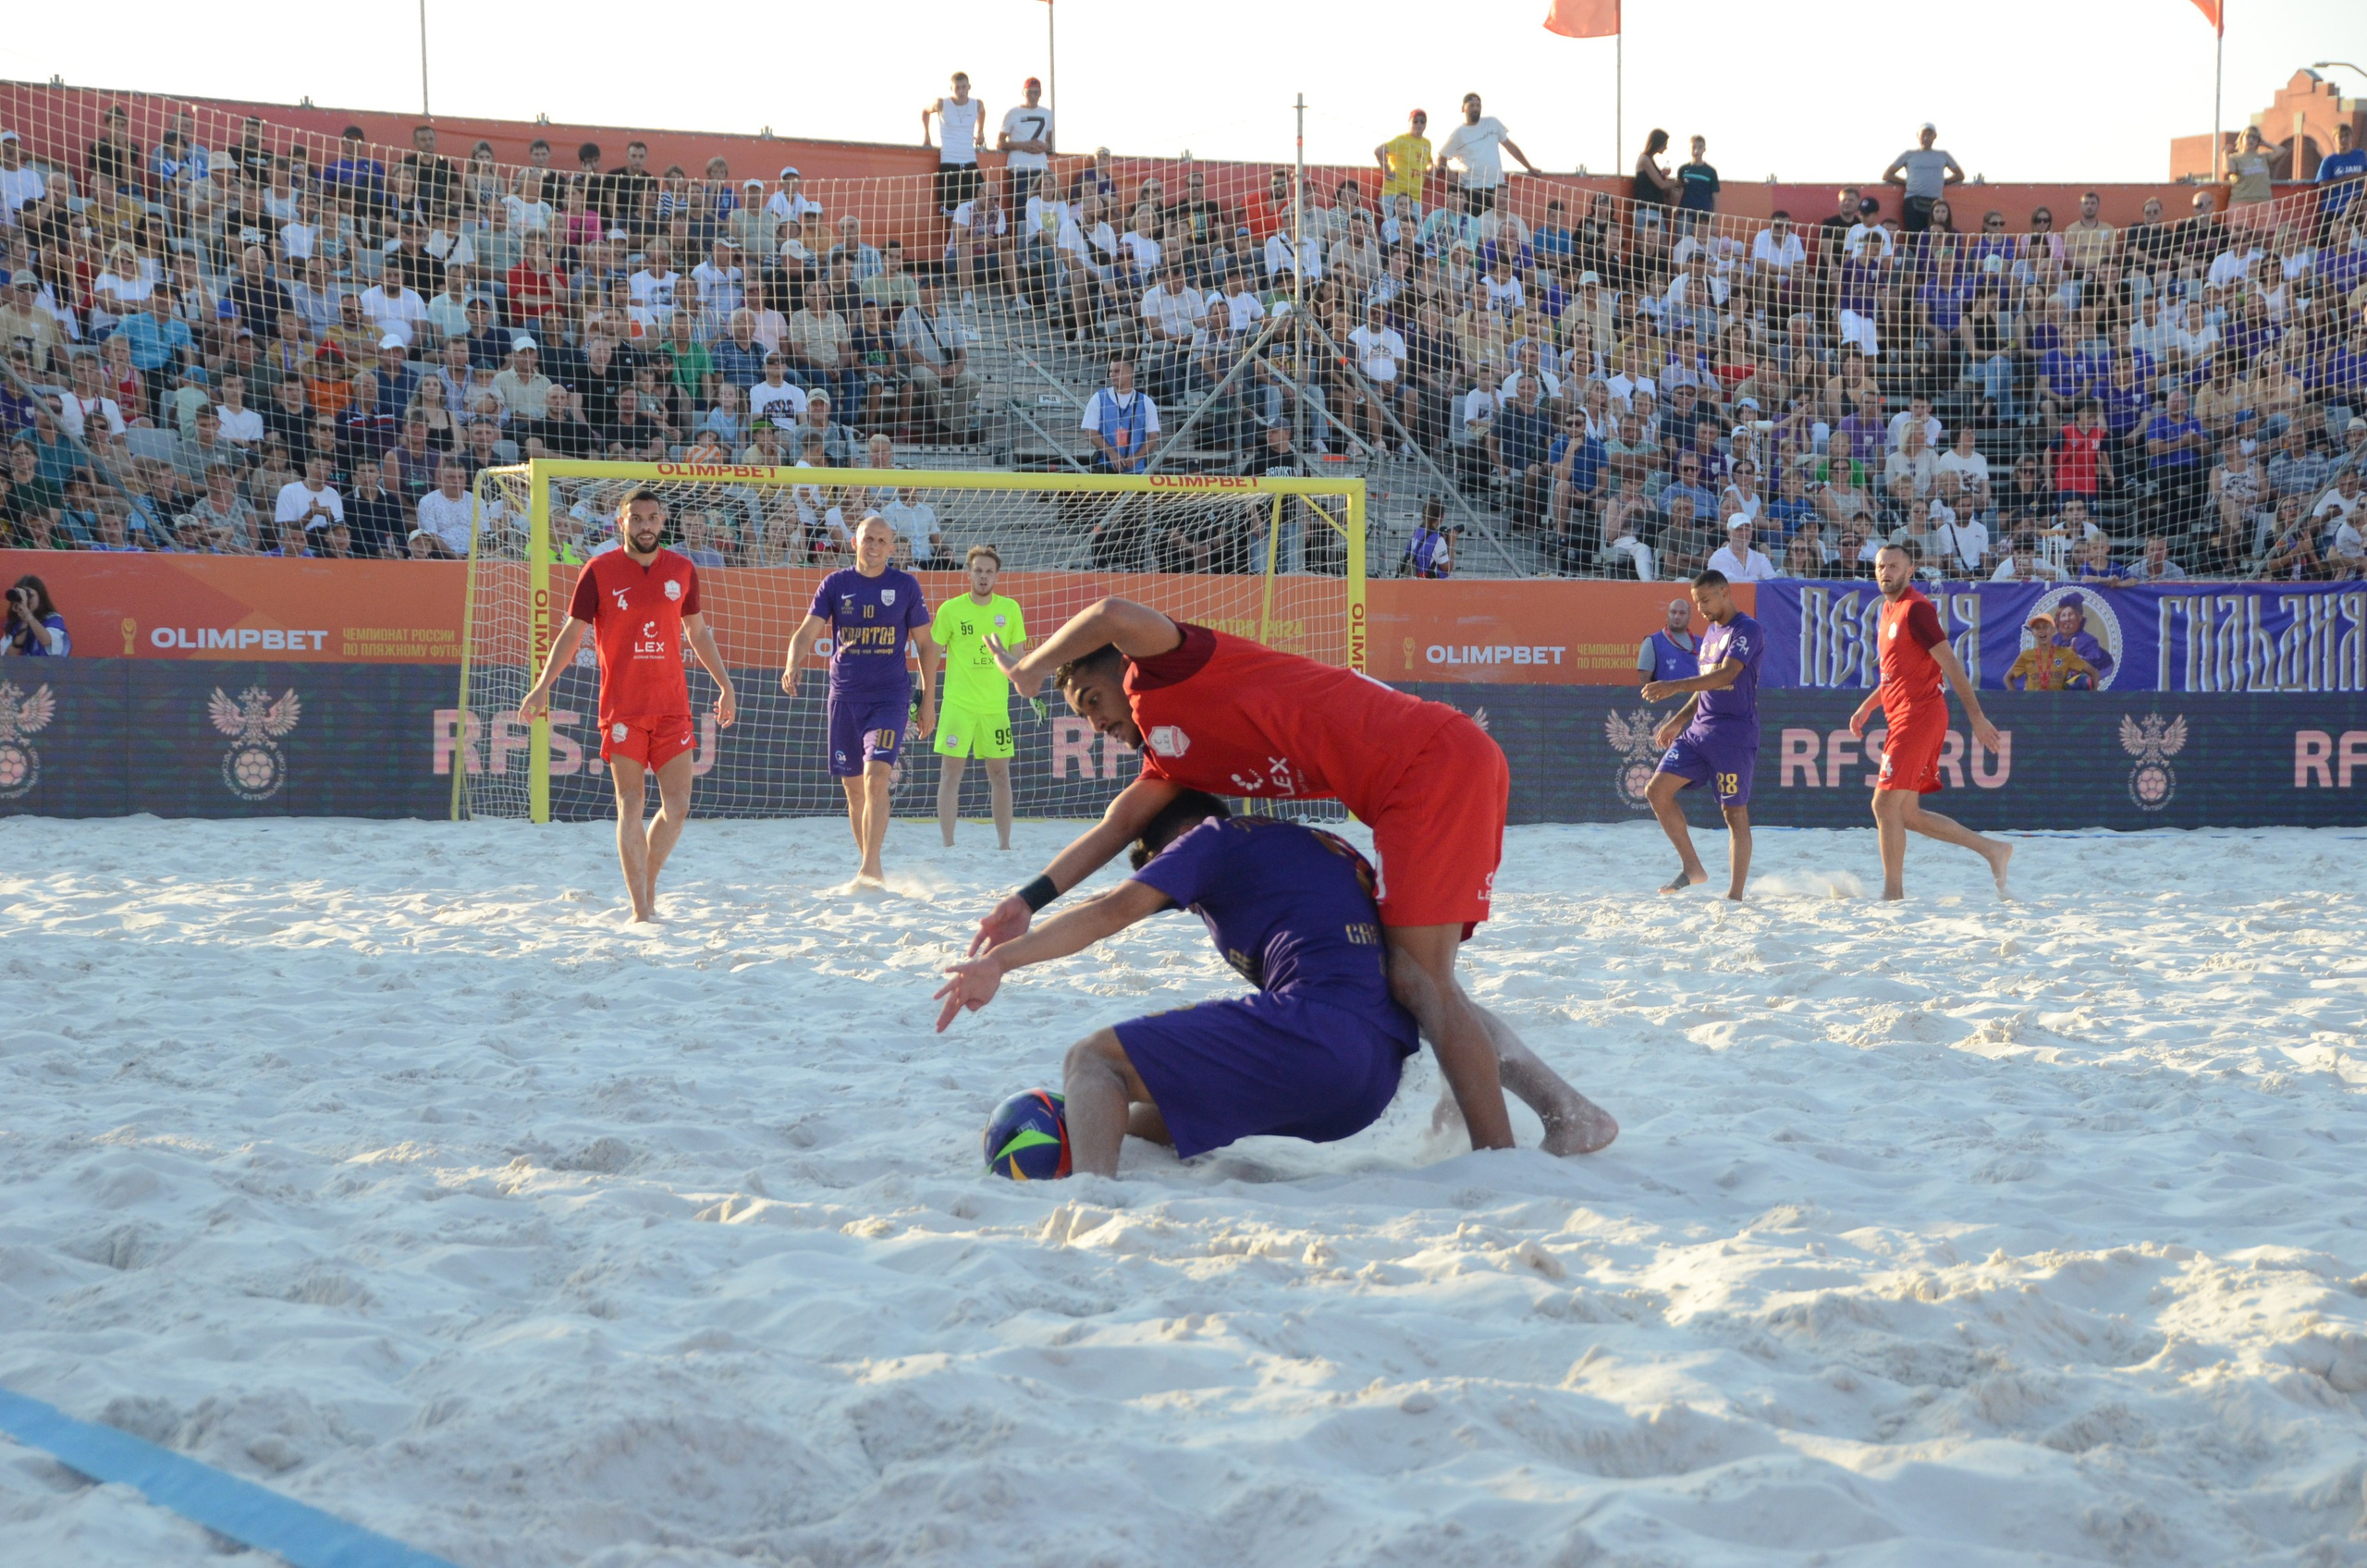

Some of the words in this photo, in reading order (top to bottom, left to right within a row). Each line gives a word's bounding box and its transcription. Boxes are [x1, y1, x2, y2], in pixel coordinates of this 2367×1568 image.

[657, 463, 778, 479] OLIMPBET
[1149, 475, 1258, 487] OLIMPBET
[618, 594, 629, 610] 4
[863, 604, 875, 619] 10
[343, 628, 408, 642] ЧЕМПИОНАТ
[411, 630, 455, 642] РОССИИ
[961, 624, 975, 636] 99
[151, 627, 328, 651] OLIMPBET
[343, 643, 358, 655] ПО
[362, 643, 427, 657] ПЛЯЖНОМУ
[635, 642, 665, 653] LEX
[1426, 645, 1566, 665] OLIMPBET
[1577, 643, 1630, 655] ЧЕМПИОНАТ
[535, 589, 548, 722] OLIMPT
[1577, 657, 1589, 669] ПО
[876, 729, 896, 750] 10
[995, 729, 1012, 745] 99
[1716, 772, 1737, 794] 88
